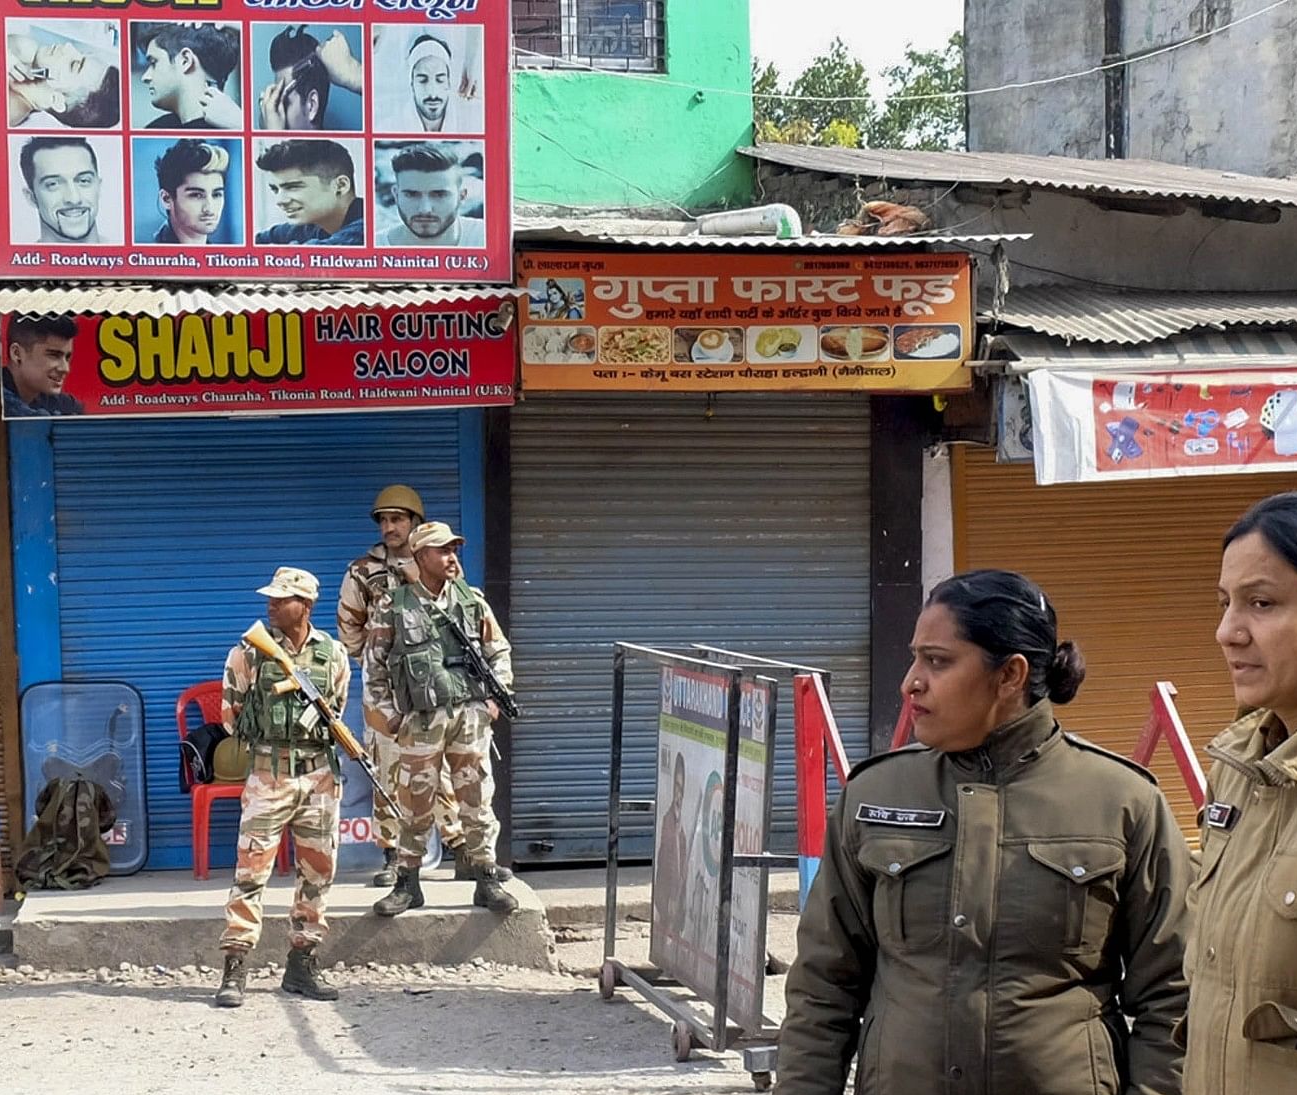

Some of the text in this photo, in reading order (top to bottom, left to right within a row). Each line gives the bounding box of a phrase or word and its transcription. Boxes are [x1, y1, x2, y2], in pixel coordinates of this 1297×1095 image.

[10, 252, 490, 270] Add- Roadways Chauraha, Tikonia Road, Haldwani Nainital (U.K.)
[591, 273, 960, 319] गुप्ता फास्ट फूड
[315, 309, 507, 342] HAIR CUTTING
[644, 307, 676, 320] हमारे
[704, 306, 733, 319] शादी
[734, 305, 758, 319] पार्टी
[865, 306, 890, 318] जाते
[98, 313, 305, 384] SHAHJI
[354, 348, 470, 379] SALOON
[593, 370, 618, 379] पता
[100, 383, 513, 406] Add- Roadways Chauraha, Tikonia Road, Haldwani Nainital (U.K.)
